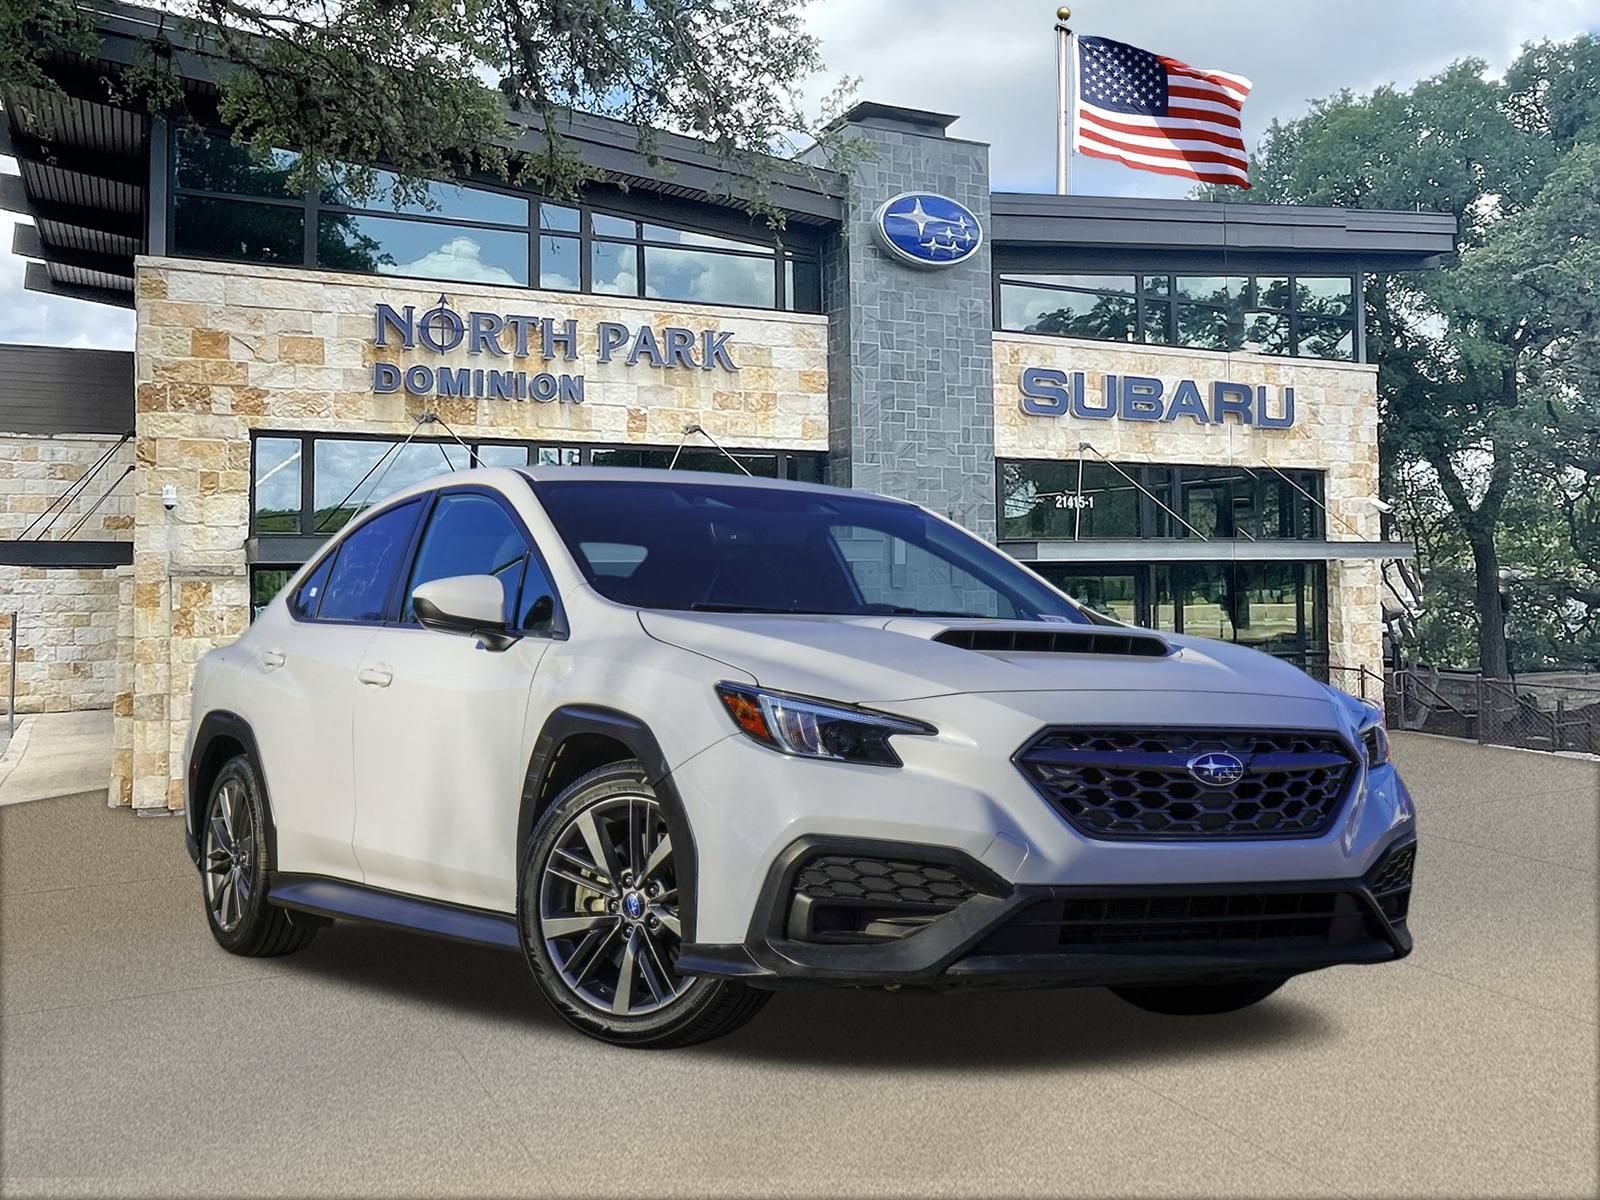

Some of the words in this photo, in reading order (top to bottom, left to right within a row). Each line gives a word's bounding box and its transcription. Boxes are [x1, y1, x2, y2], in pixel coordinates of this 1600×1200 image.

[374, 302, 579, 361] NORTH
[596, 321, 741, 373] PARK
[372, 362, 585, 404] DOMINION
[1019, 367, 1295, 430] SUBARU
